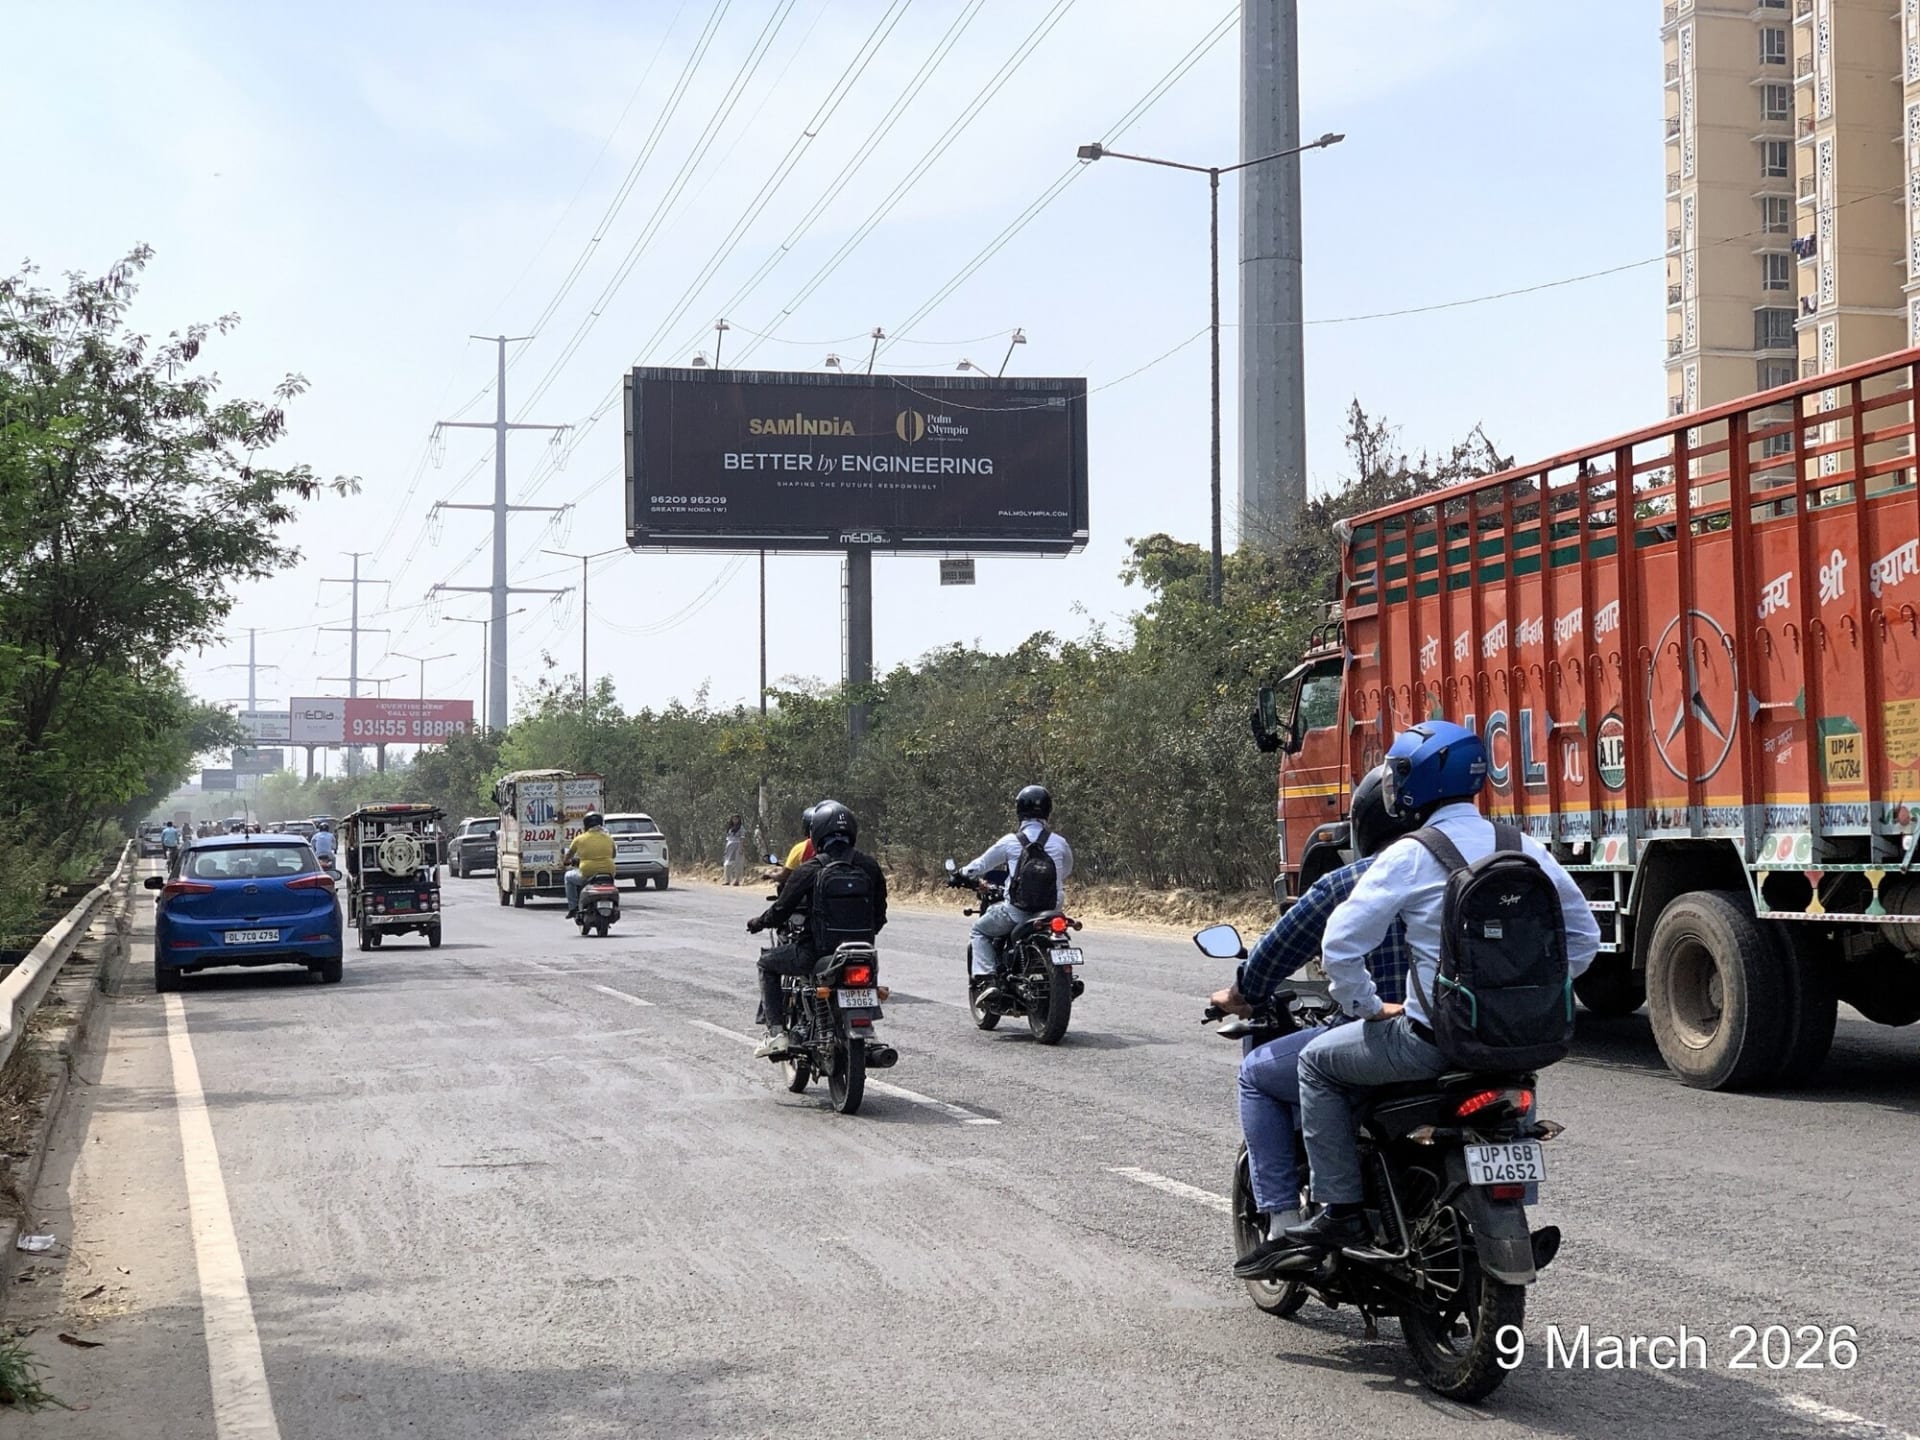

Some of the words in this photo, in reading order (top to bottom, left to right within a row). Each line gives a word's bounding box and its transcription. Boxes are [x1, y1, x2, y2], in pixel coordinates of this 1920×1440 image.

[927, 413, 952, 424] Palm
[927, 424, 969, 437] Olympia
[724, 453, 813, 470] BETTER
[817, 454, 838, 475] by
[841, 455, 993, 474] ENGINEERING
[776, 480, 816, 488] SHAPING
[650, 496, 688, 504] 96209
[690, 496, 727, 504] 96209
[1757, 571, 1793, 620] जय
[1819, 548, 1848, 607] श्री
[1454, 630, 1470, 663] का
[352, 719, 407, 736] 93555
[412, 720, 465, 736] 98888
[1464, 708, 1548, 787] CL
[524, 829, 556, 841] BLOW
[1480, 1145, 1533, 1163] UP16B
[1483, 1164, 1537, 1182] D4652
